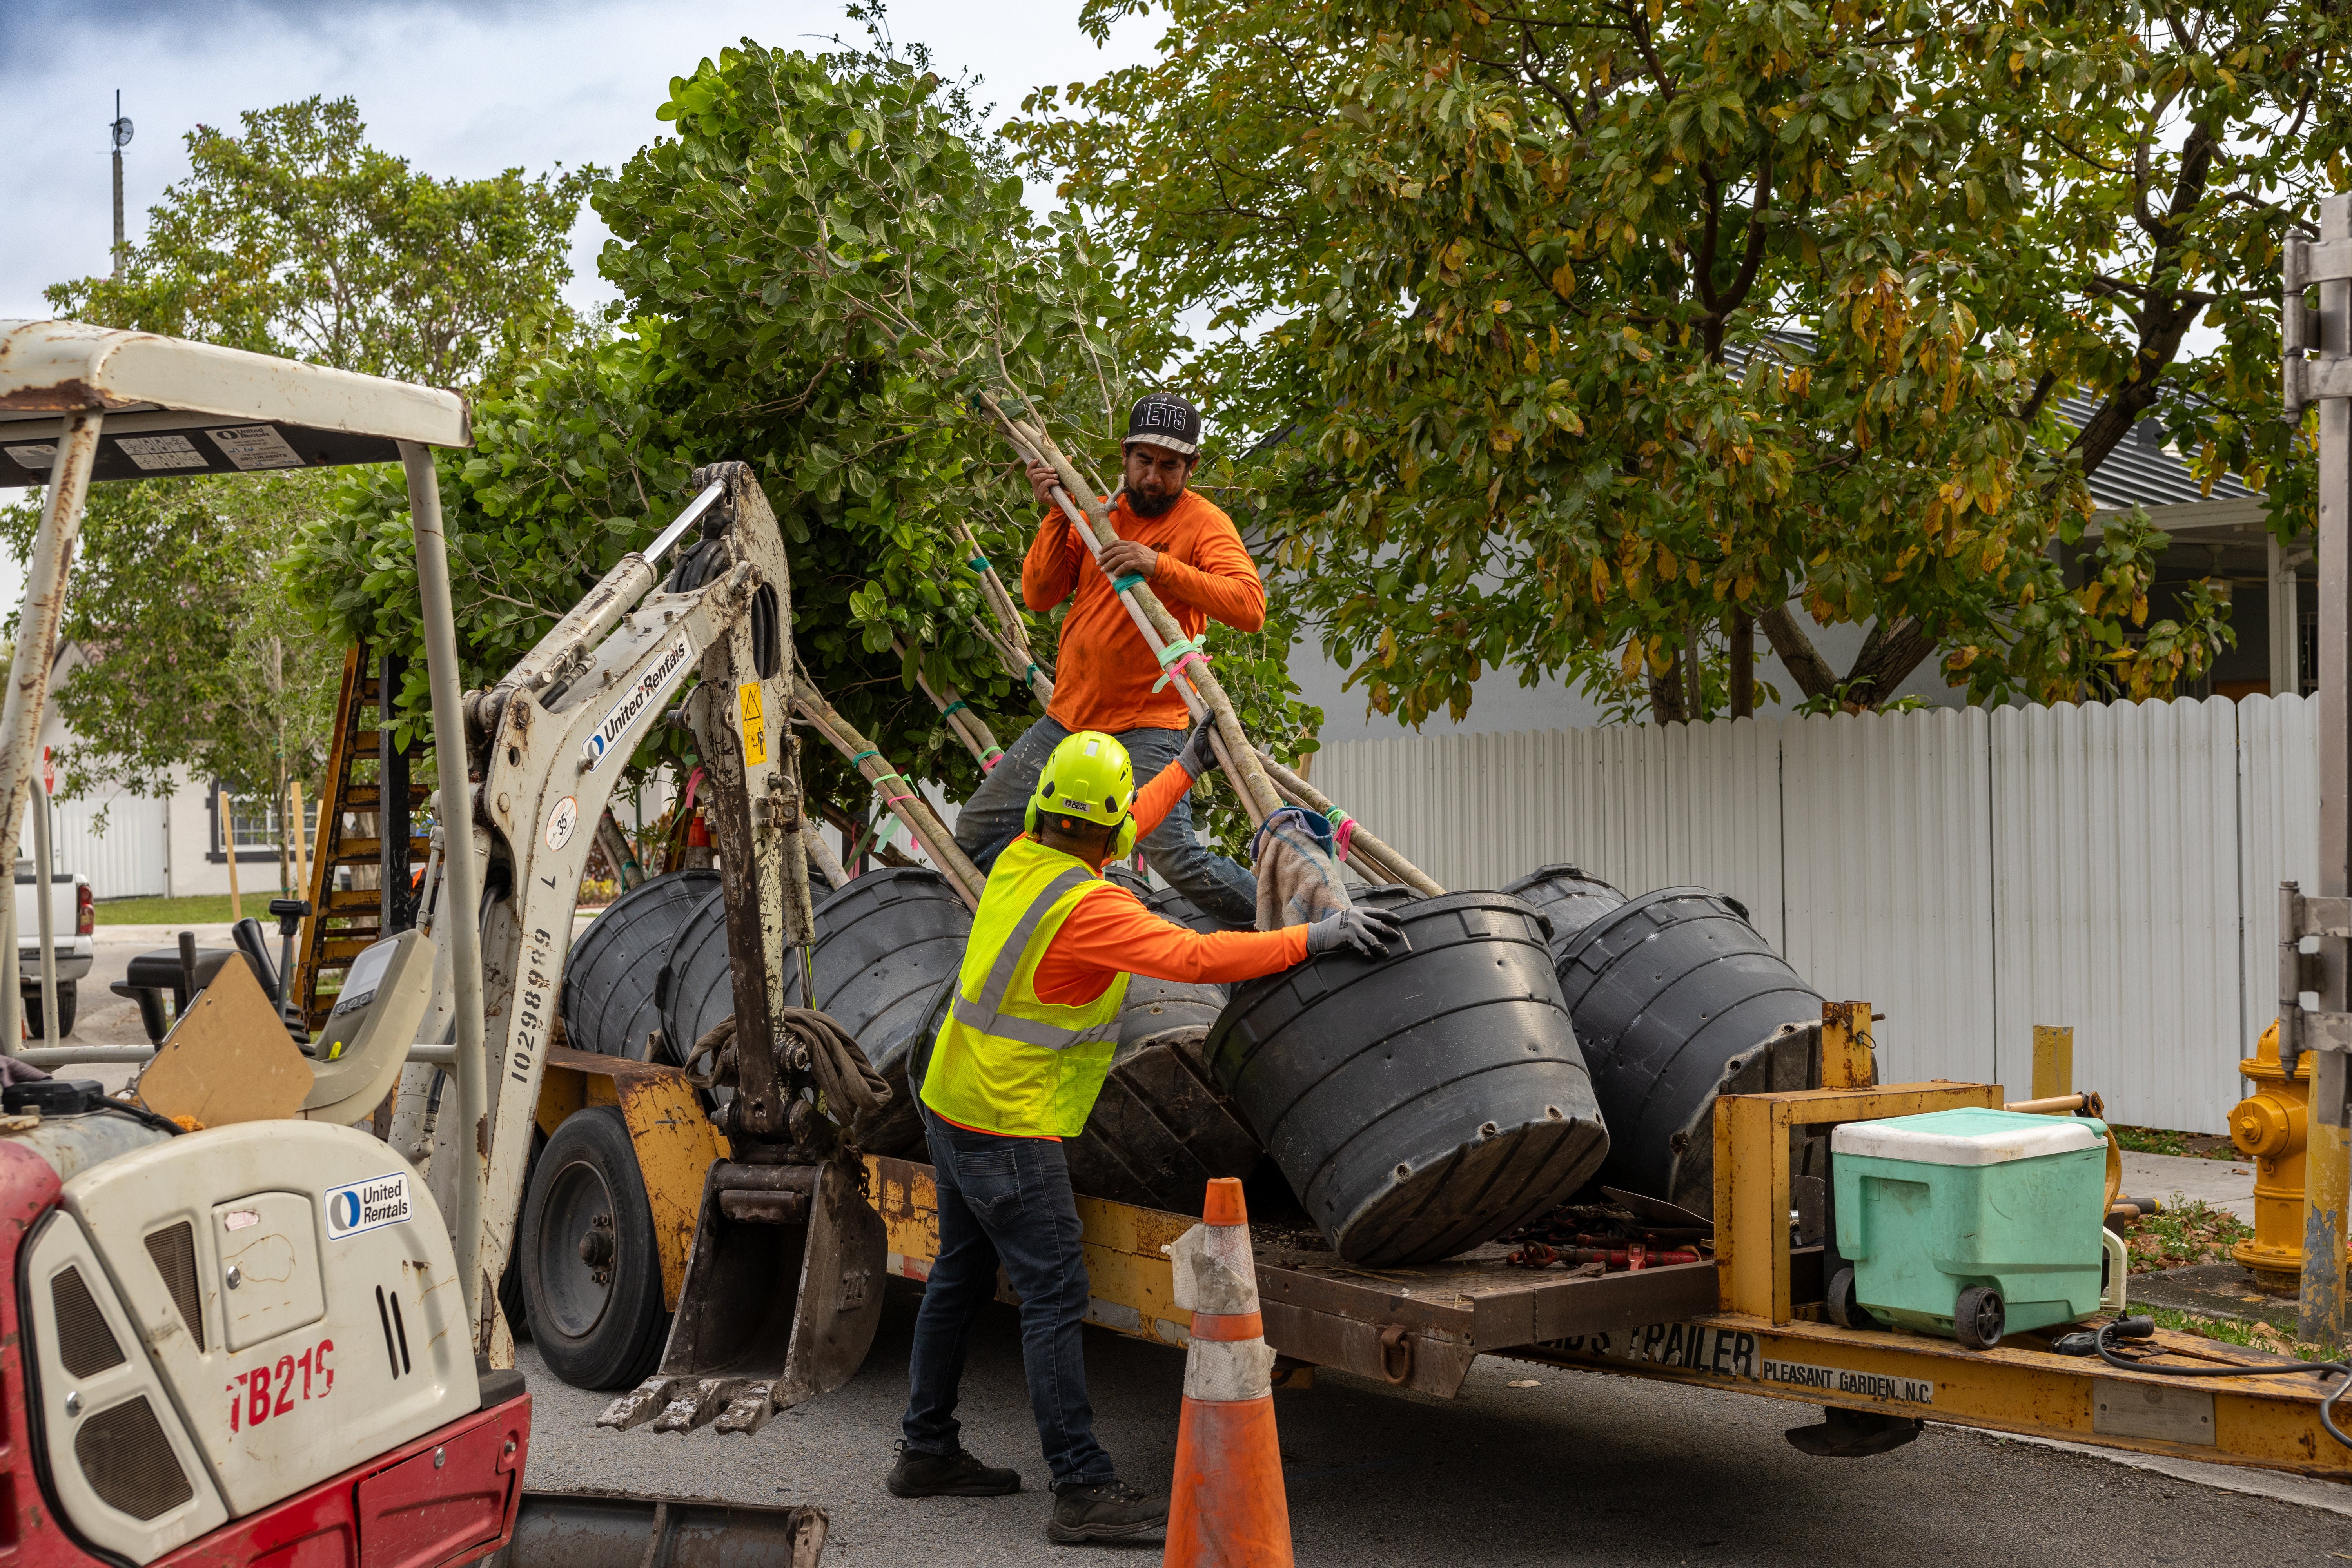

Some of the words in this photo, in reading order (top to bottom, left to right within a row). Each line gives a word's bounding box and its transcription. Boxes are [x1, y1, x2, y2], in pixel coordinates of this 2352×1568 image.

[1138, 403, 1186, 431] NETS
[604, 685, 644, 742] United
[644, 643, 685, 698] Rentals
[557, 813, 567, 835] 35
[1445, 896, 1481, 906] GALLONS
[363, 1180, 401, 1204] United
[364, 1199, 407, 1224] Rentals
[1628, 1322, 1755, 1377] TRAILER
[1764, 1361, 1833, 1388] PLEASANT
[1906, 1381, 1932, 1405] N.C.
